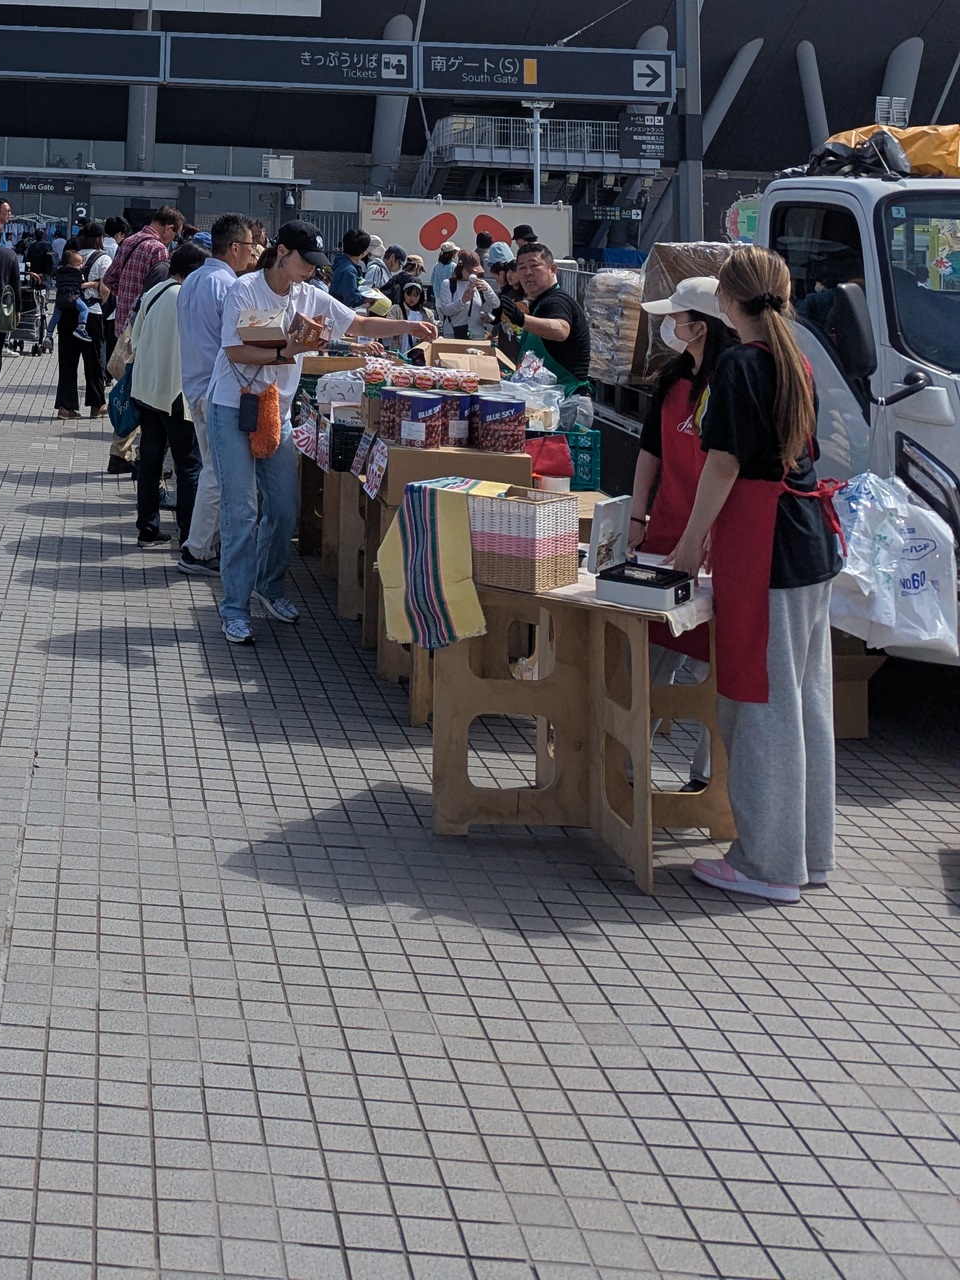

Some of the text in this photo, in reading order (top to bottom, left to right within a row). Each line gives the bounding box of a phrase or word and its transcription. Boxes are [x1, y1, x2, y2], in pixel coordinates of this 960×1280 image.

[300, 51, 378, 69] きっぷうりば
[431, 56, 520, 74] 南ゲート(S)
[341, 68, 378, 79] Tickets
[462, 72, 518, 84] South Gate
[19, 183, 54, 191] Main Gate
[418, 408, 433, 419] BLUE
[486, 408, 515, 422] BLUE SKY
